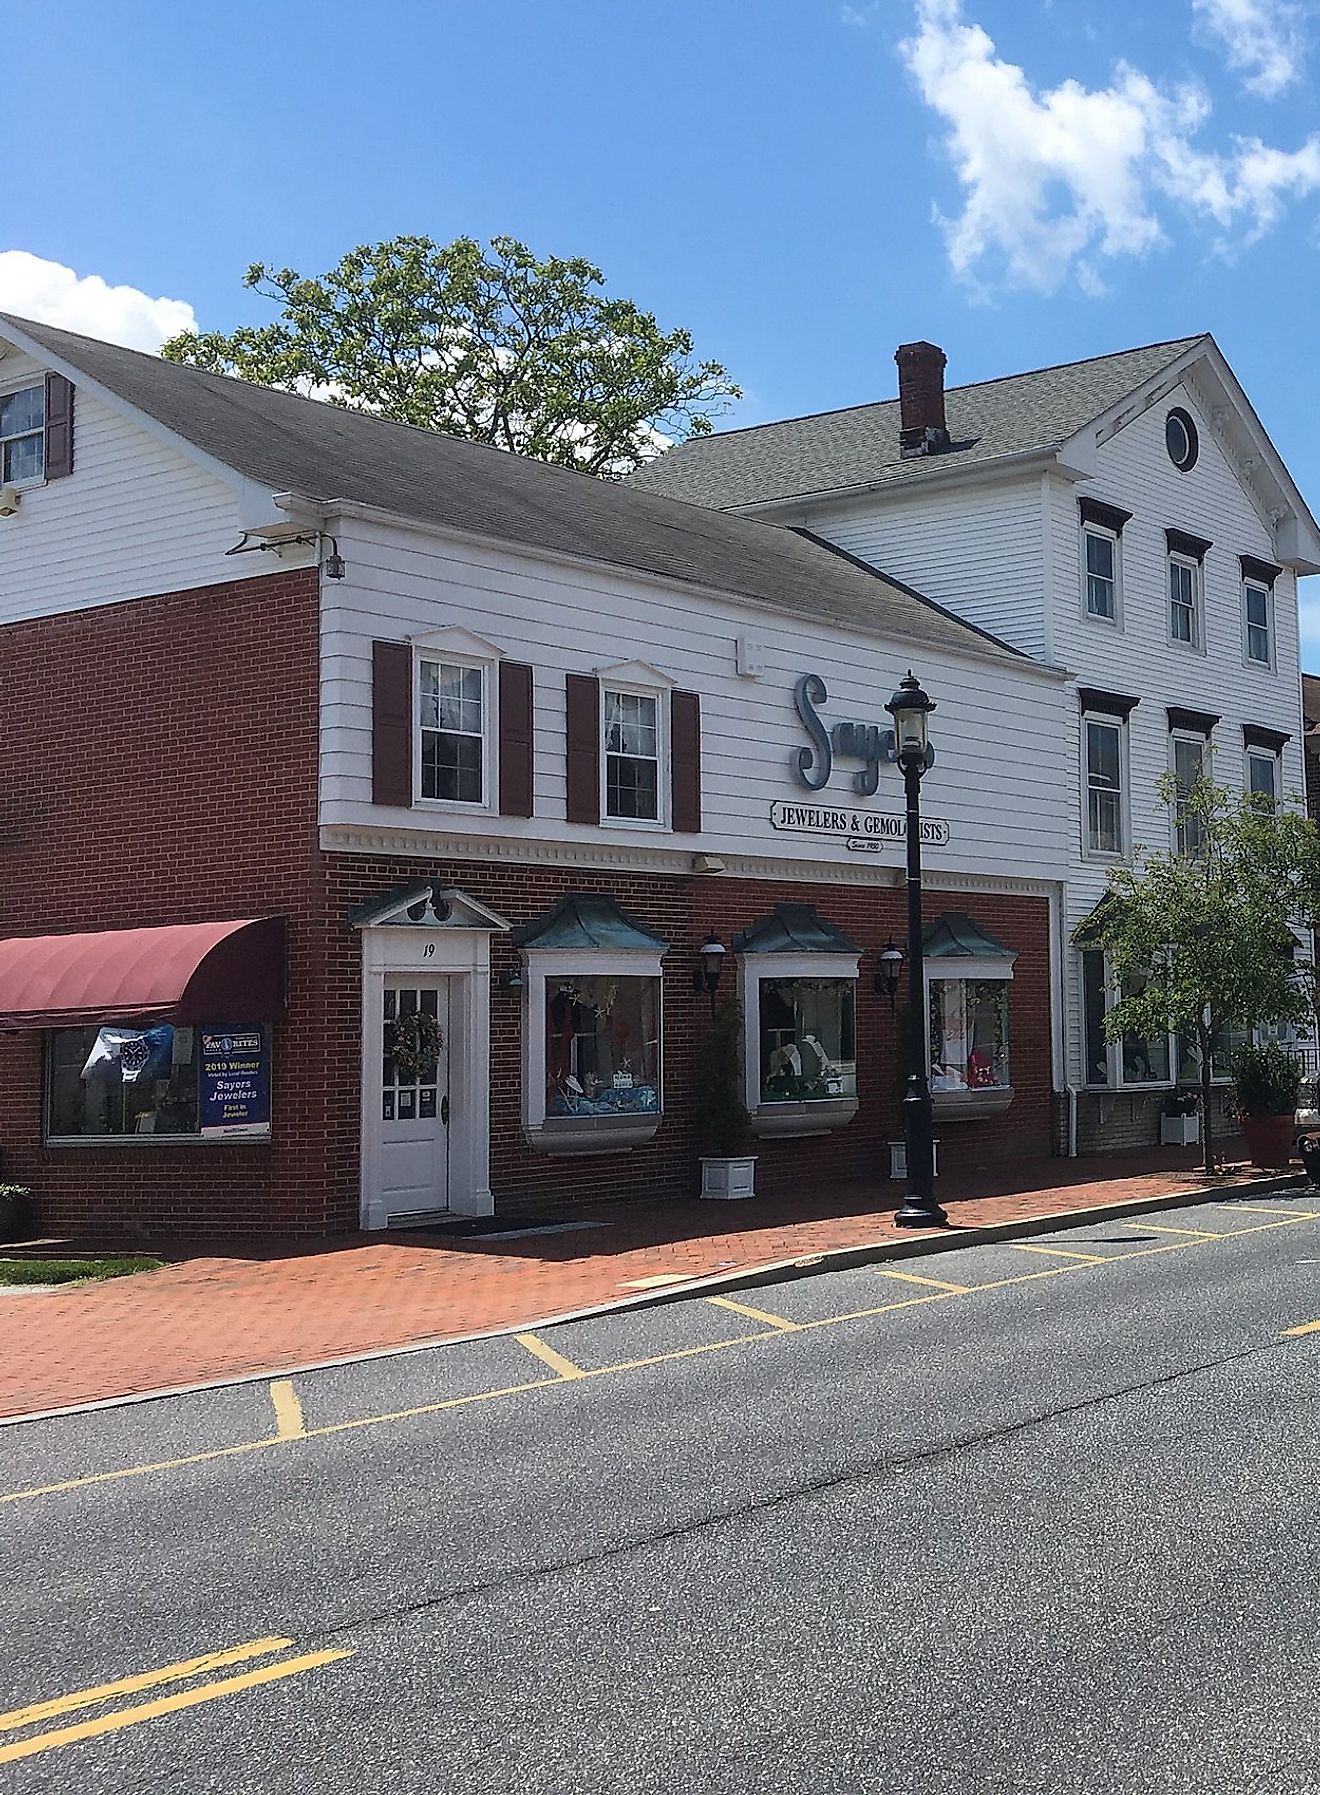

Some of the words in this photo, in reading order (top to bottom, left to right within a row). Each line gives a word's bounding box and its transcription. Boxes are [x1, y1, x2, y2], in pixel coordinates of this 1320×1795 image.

[781, 807, 847, 830] JEWELERS
[850, 815, 860, 832] &
[864, 816, 943, 840] GEMOLISTS
[423, 944, 435, 957] 19
[205, 1062, 227, 1071] 2019
[229, 1061, 260, 1070] Winner
[216, 1080, 251, 1091] Sayers
[209, 1090, 257, 1101] Jewelers
